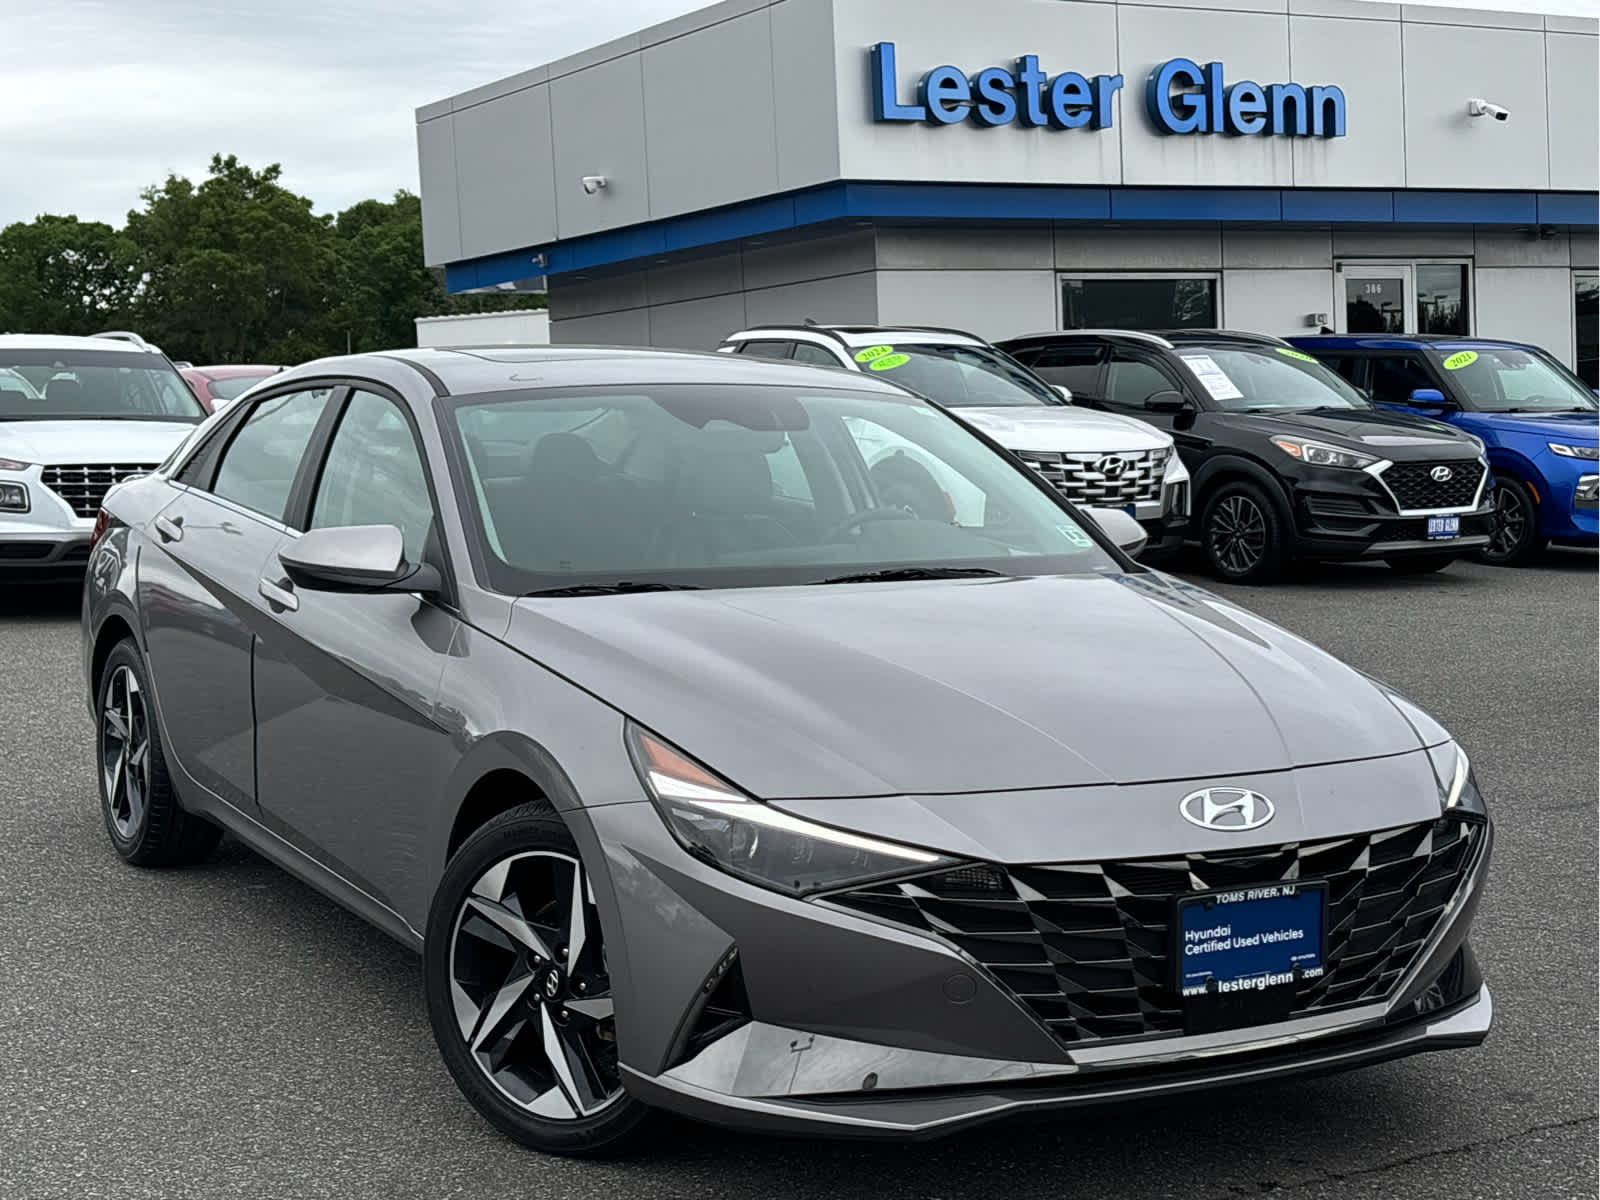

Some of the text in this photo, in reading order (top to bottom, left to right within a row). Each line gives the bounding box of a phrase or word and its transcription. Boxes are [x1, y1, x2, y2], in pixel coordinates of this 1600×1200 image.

[871, 41, 1347, 138] Lester Glenn
[1450, 352, 1472, 368] 2021
[1215, 892, 1245, 904] TOMS
[1282, 885, 1297, 897] NJ
[1184, 924, 1231, 942] Hyundai
[1184, 928, 1304, 956] Certified Used Vehicles
[1182, 985, 1208, 997] www.
[1218, 972, 1294, 993] lesterglenn
[1301, 967, 1324, 979] .com
